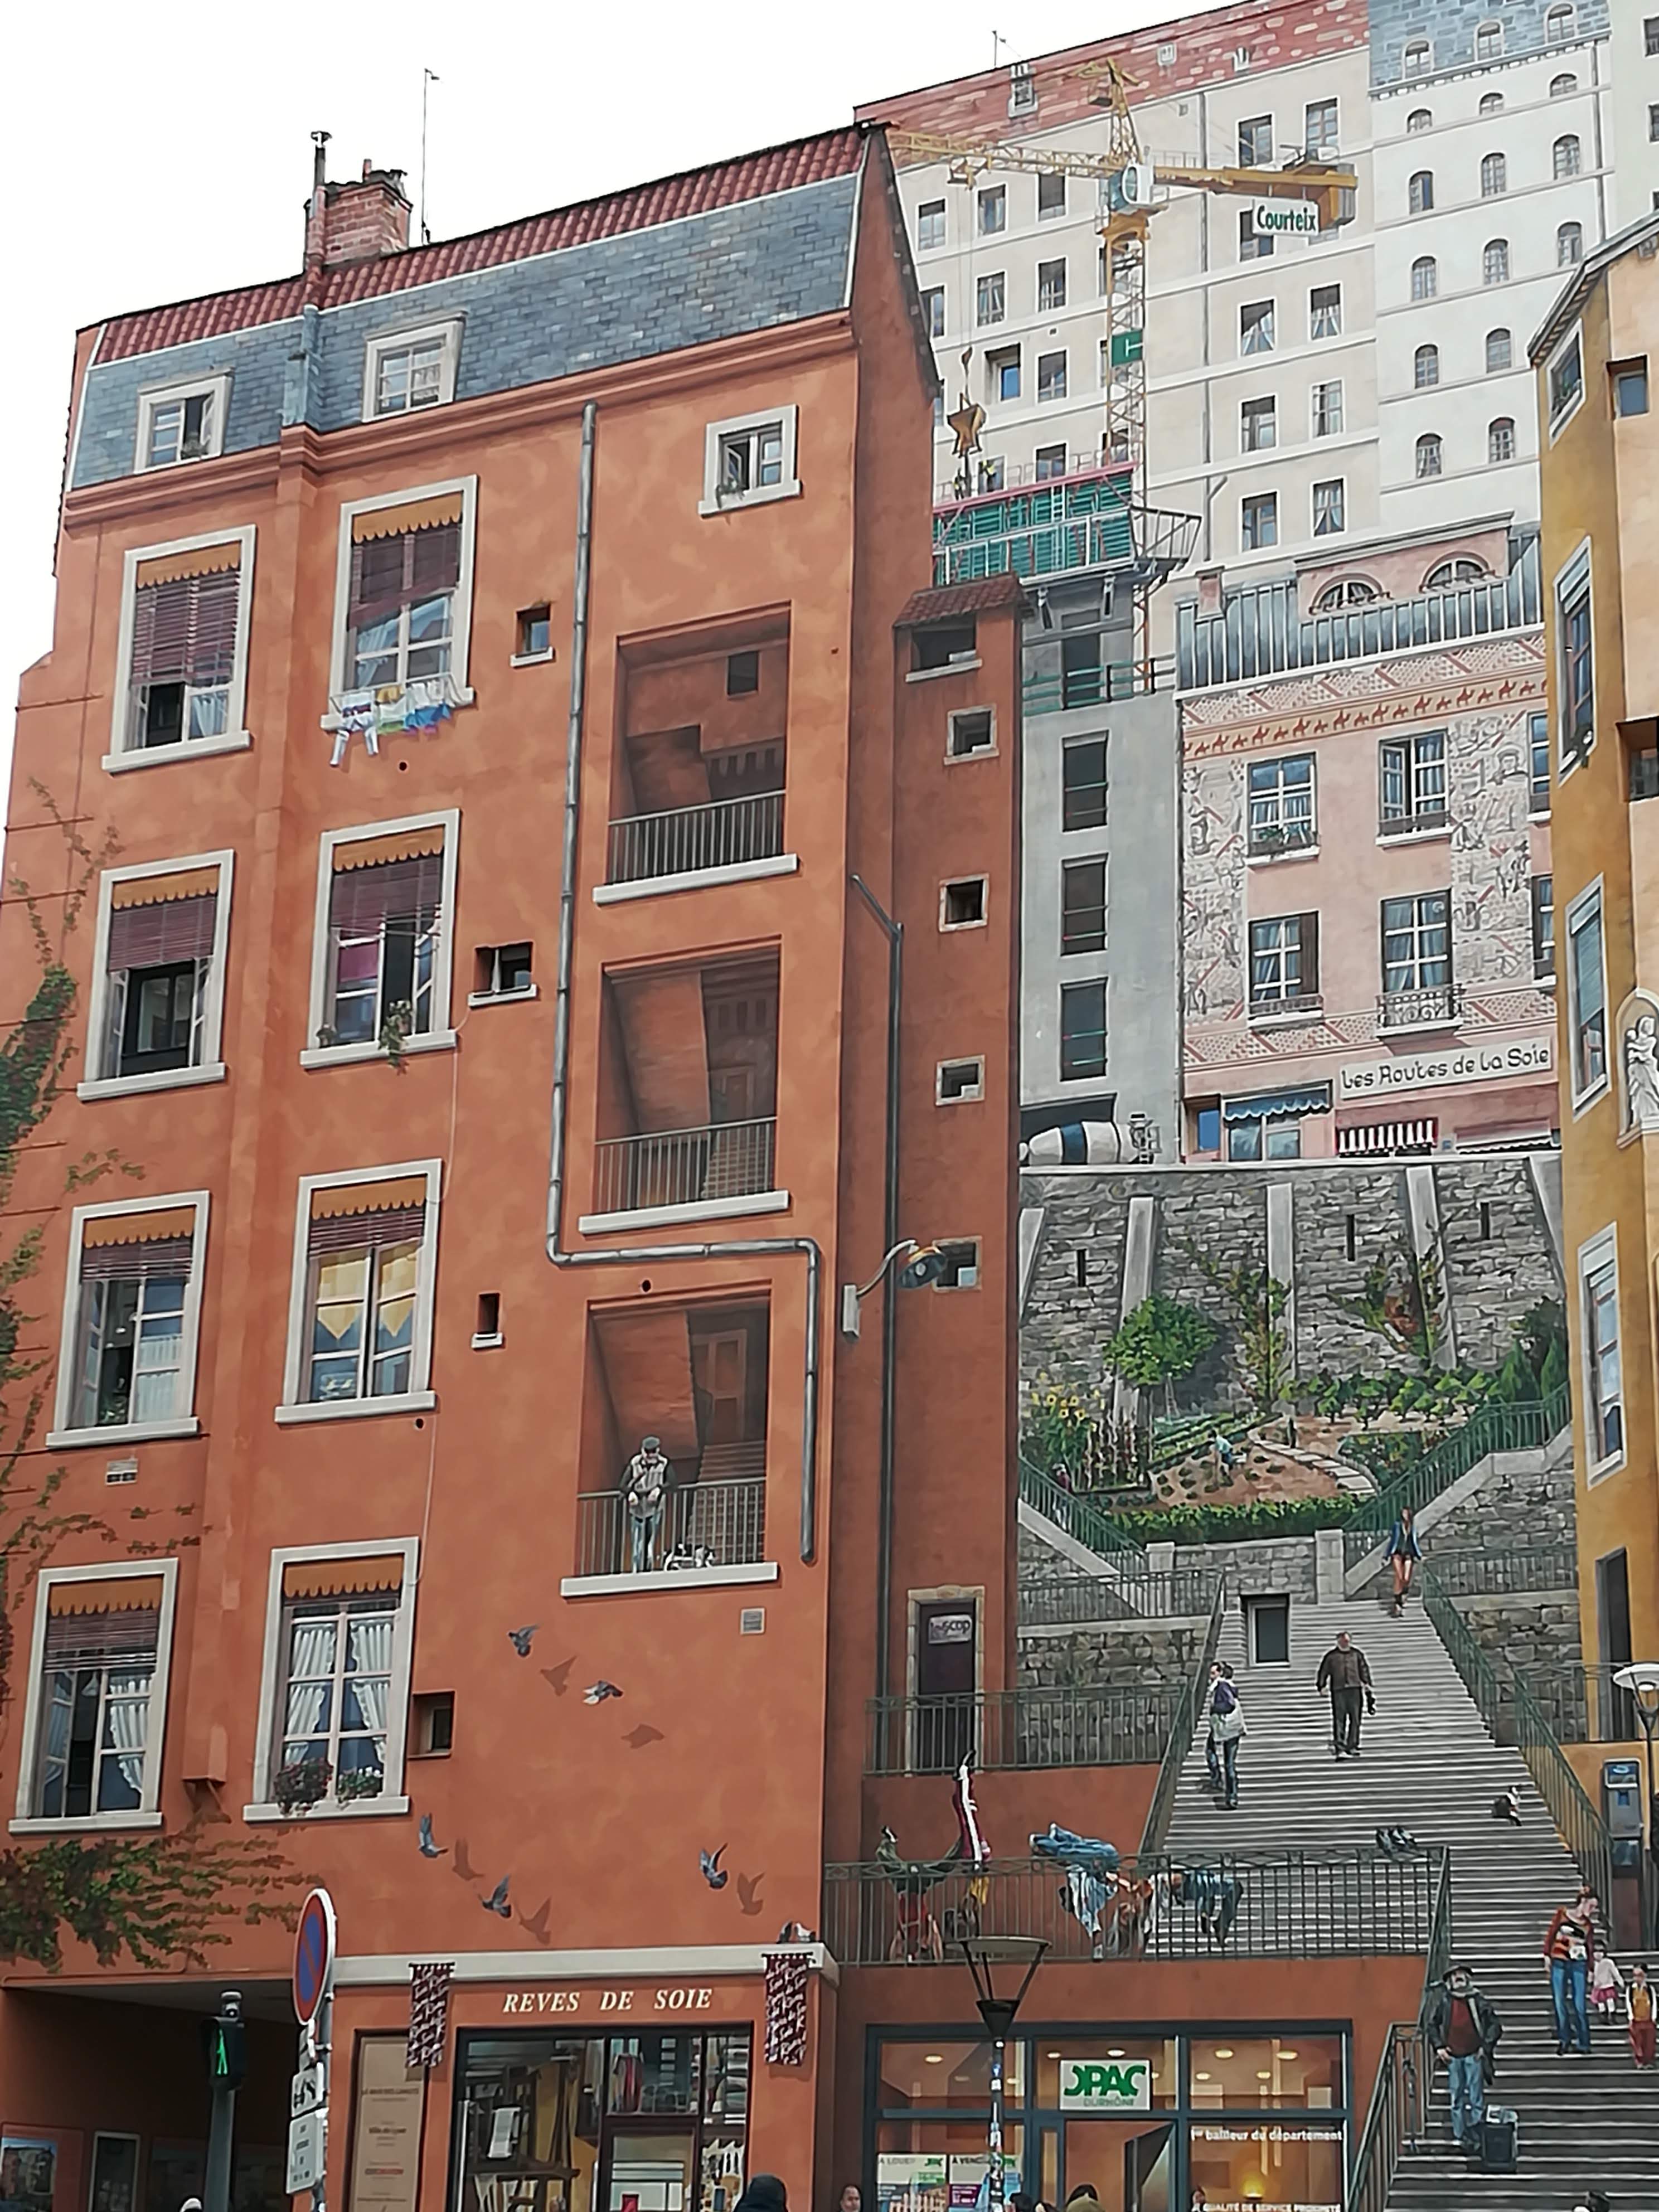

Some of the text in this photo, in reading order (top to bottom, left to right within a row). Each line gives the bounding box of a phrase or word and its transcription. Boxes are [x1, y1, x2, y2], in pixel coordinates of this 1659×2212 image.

[1257, 205, 1316, 231] Courteix
[1379, 1060, 1448, 1085] Routes
[1452, 1055, 1475, 1075] de
[1507, 1044, 1549, 1067] Soie
[502, 1988, 713, 2013] REVES DE SOIE
[1250, 2129, 1267, 2141] du
[1269, 2128, 1342, 2142] département
